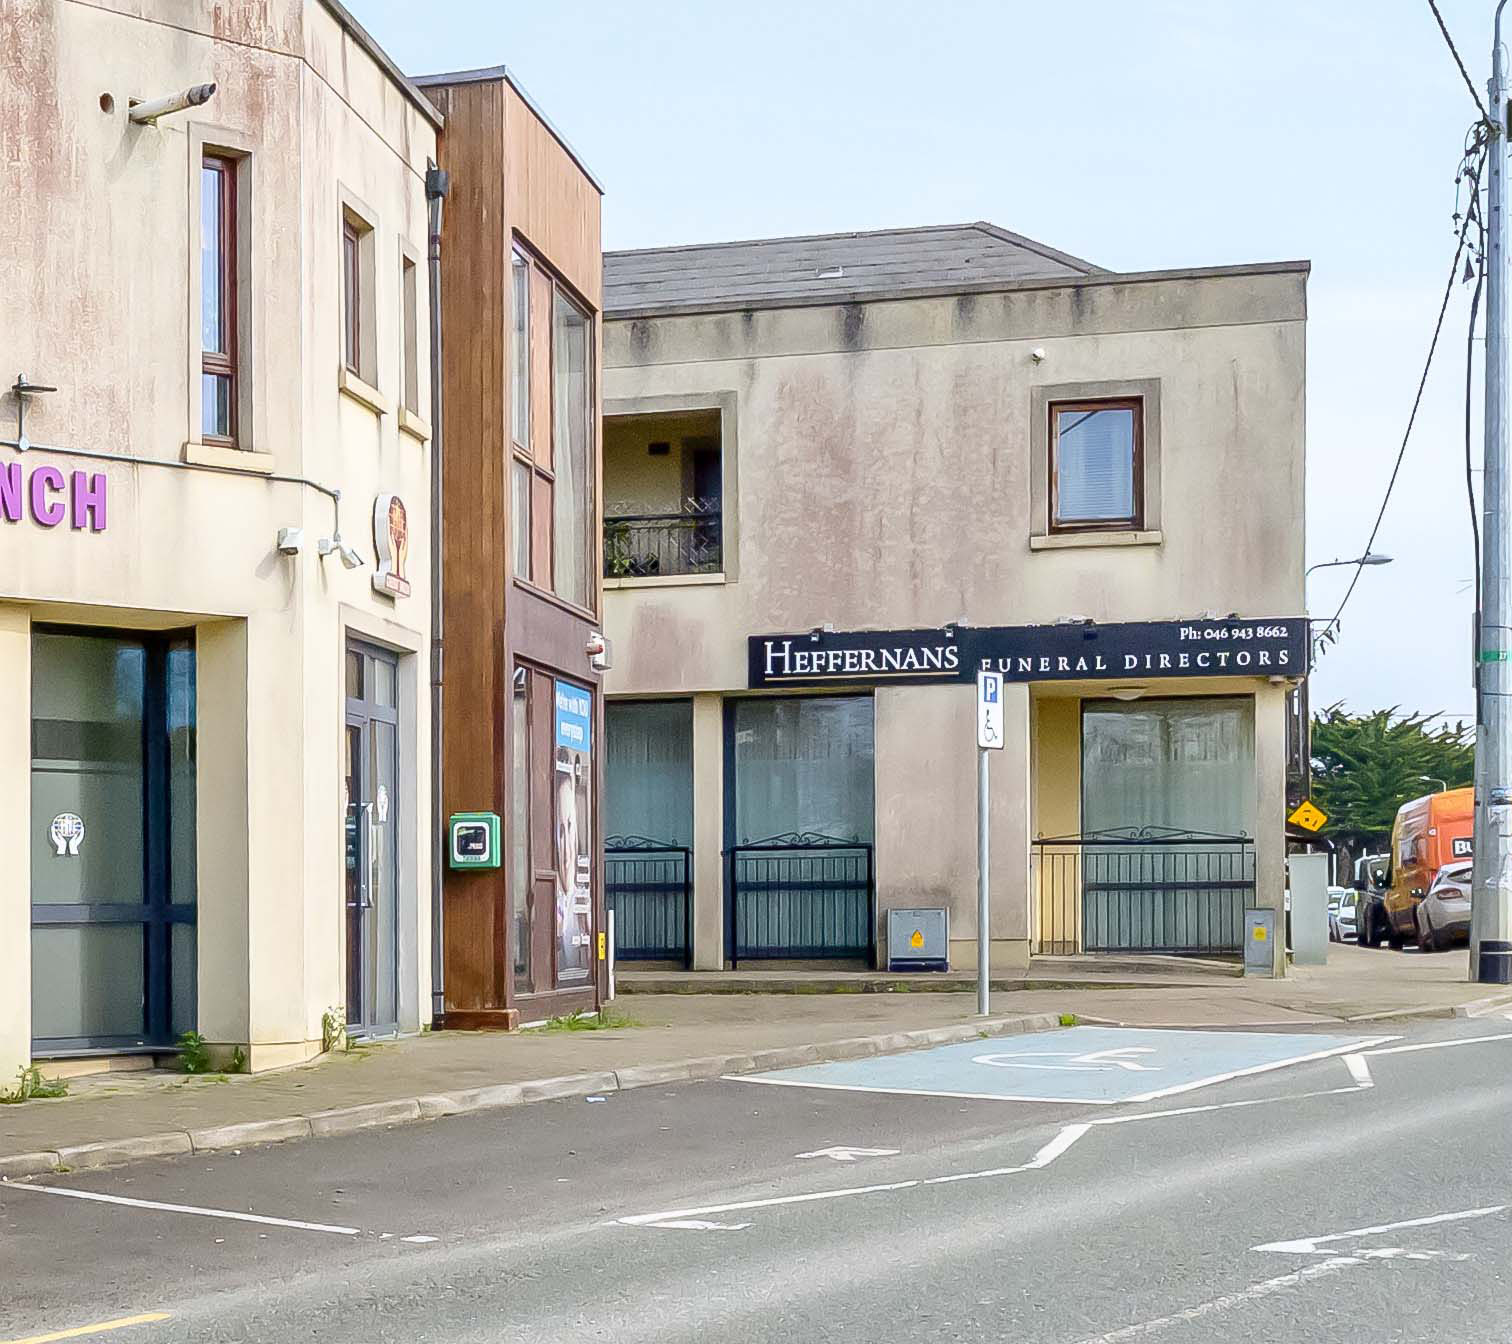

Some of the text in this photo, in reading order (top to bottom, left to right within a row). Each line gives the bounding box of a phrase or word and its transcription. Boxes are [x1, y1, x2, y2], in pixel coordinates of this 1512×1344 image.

[1180, 626, 1288, 640] Ph: 046 943 8662
[764, 641, 959, 674] HEFFERNANS
[981, 650, 1289, 673] FUNERAL DIRECTORS
[986, 678, 996, 702] P
